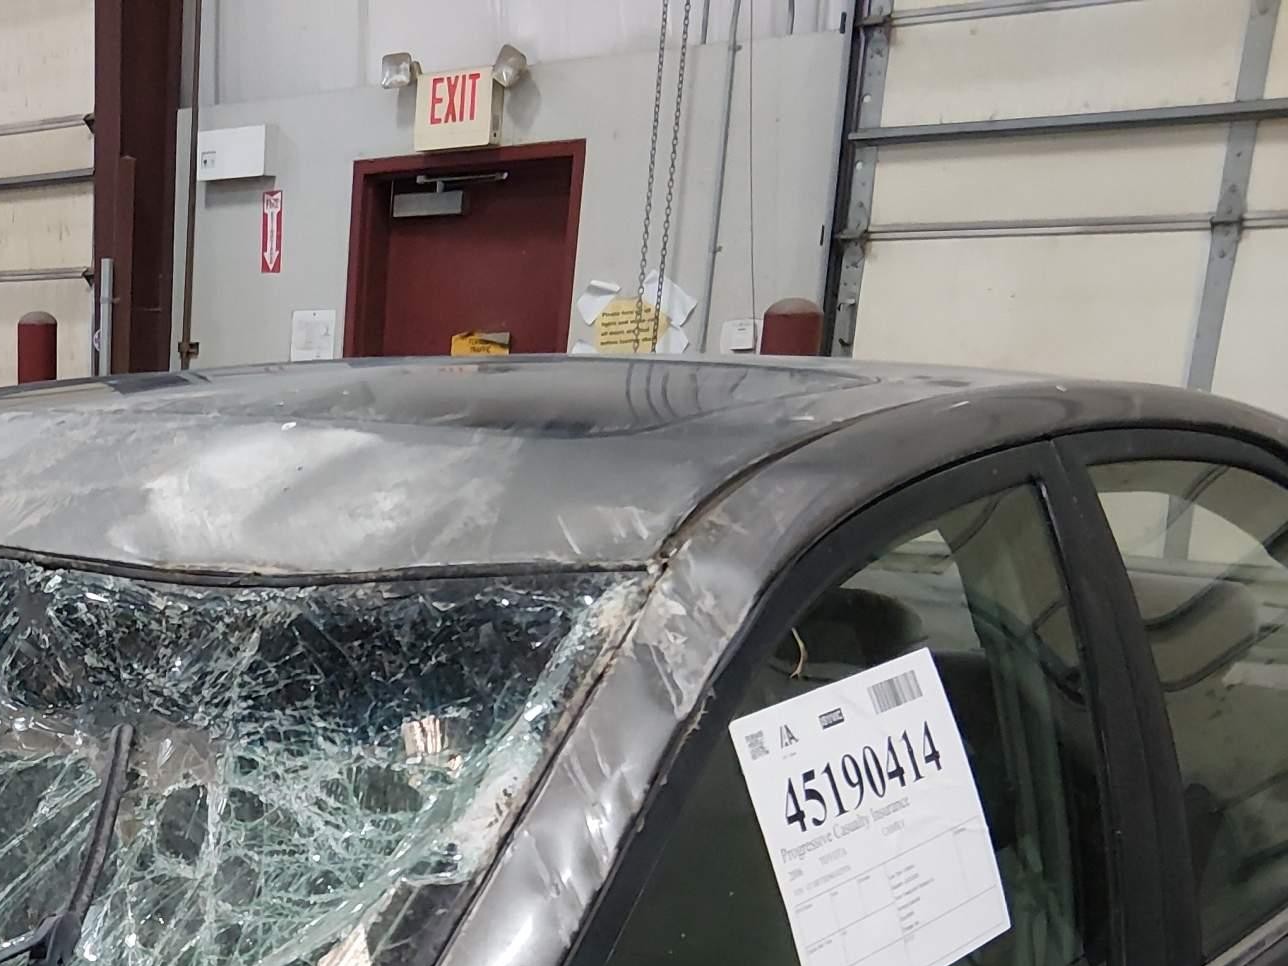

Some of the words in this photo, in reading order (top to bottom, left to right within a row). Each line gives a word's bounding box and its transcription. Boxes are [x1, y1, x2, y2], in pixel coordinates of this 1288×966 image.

[430, 73, 481, 125] EXIT
[785, 720, 942, 832] 45190414
[780, 832, 833, 864] Progressive
[833, 814, 870, 839] Casualty
[870, 797, 910, 821] Insurance
